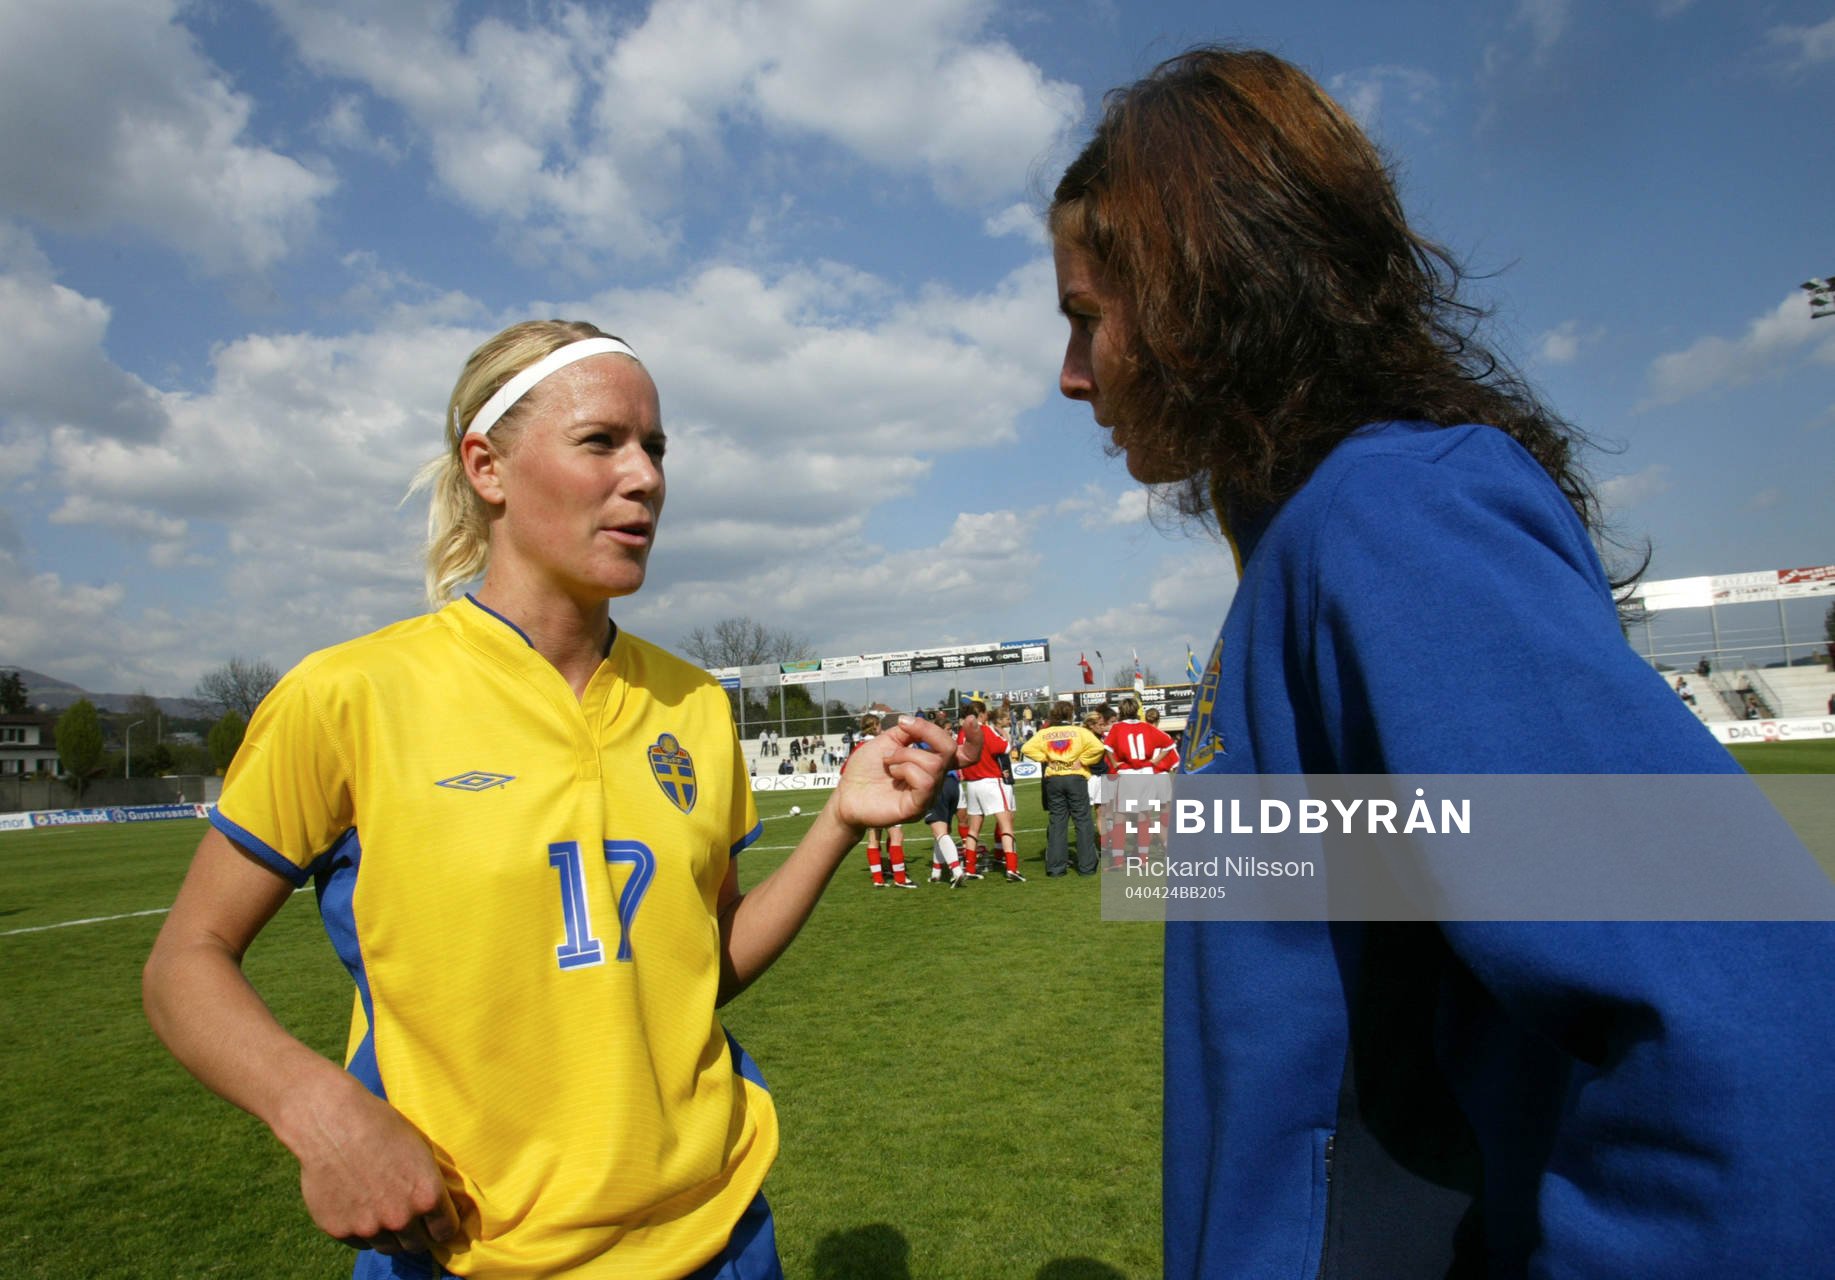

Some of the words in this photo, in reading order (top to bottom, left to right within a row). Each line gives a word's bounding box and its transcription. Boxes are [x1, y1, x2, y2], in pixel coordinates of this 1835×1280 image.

[1127, 733, 1146, 760] 11
[1015, 764, 1037, 776] SPP
[0, 818, 24, 829] nor
[547, 839, 657, 971] 17
